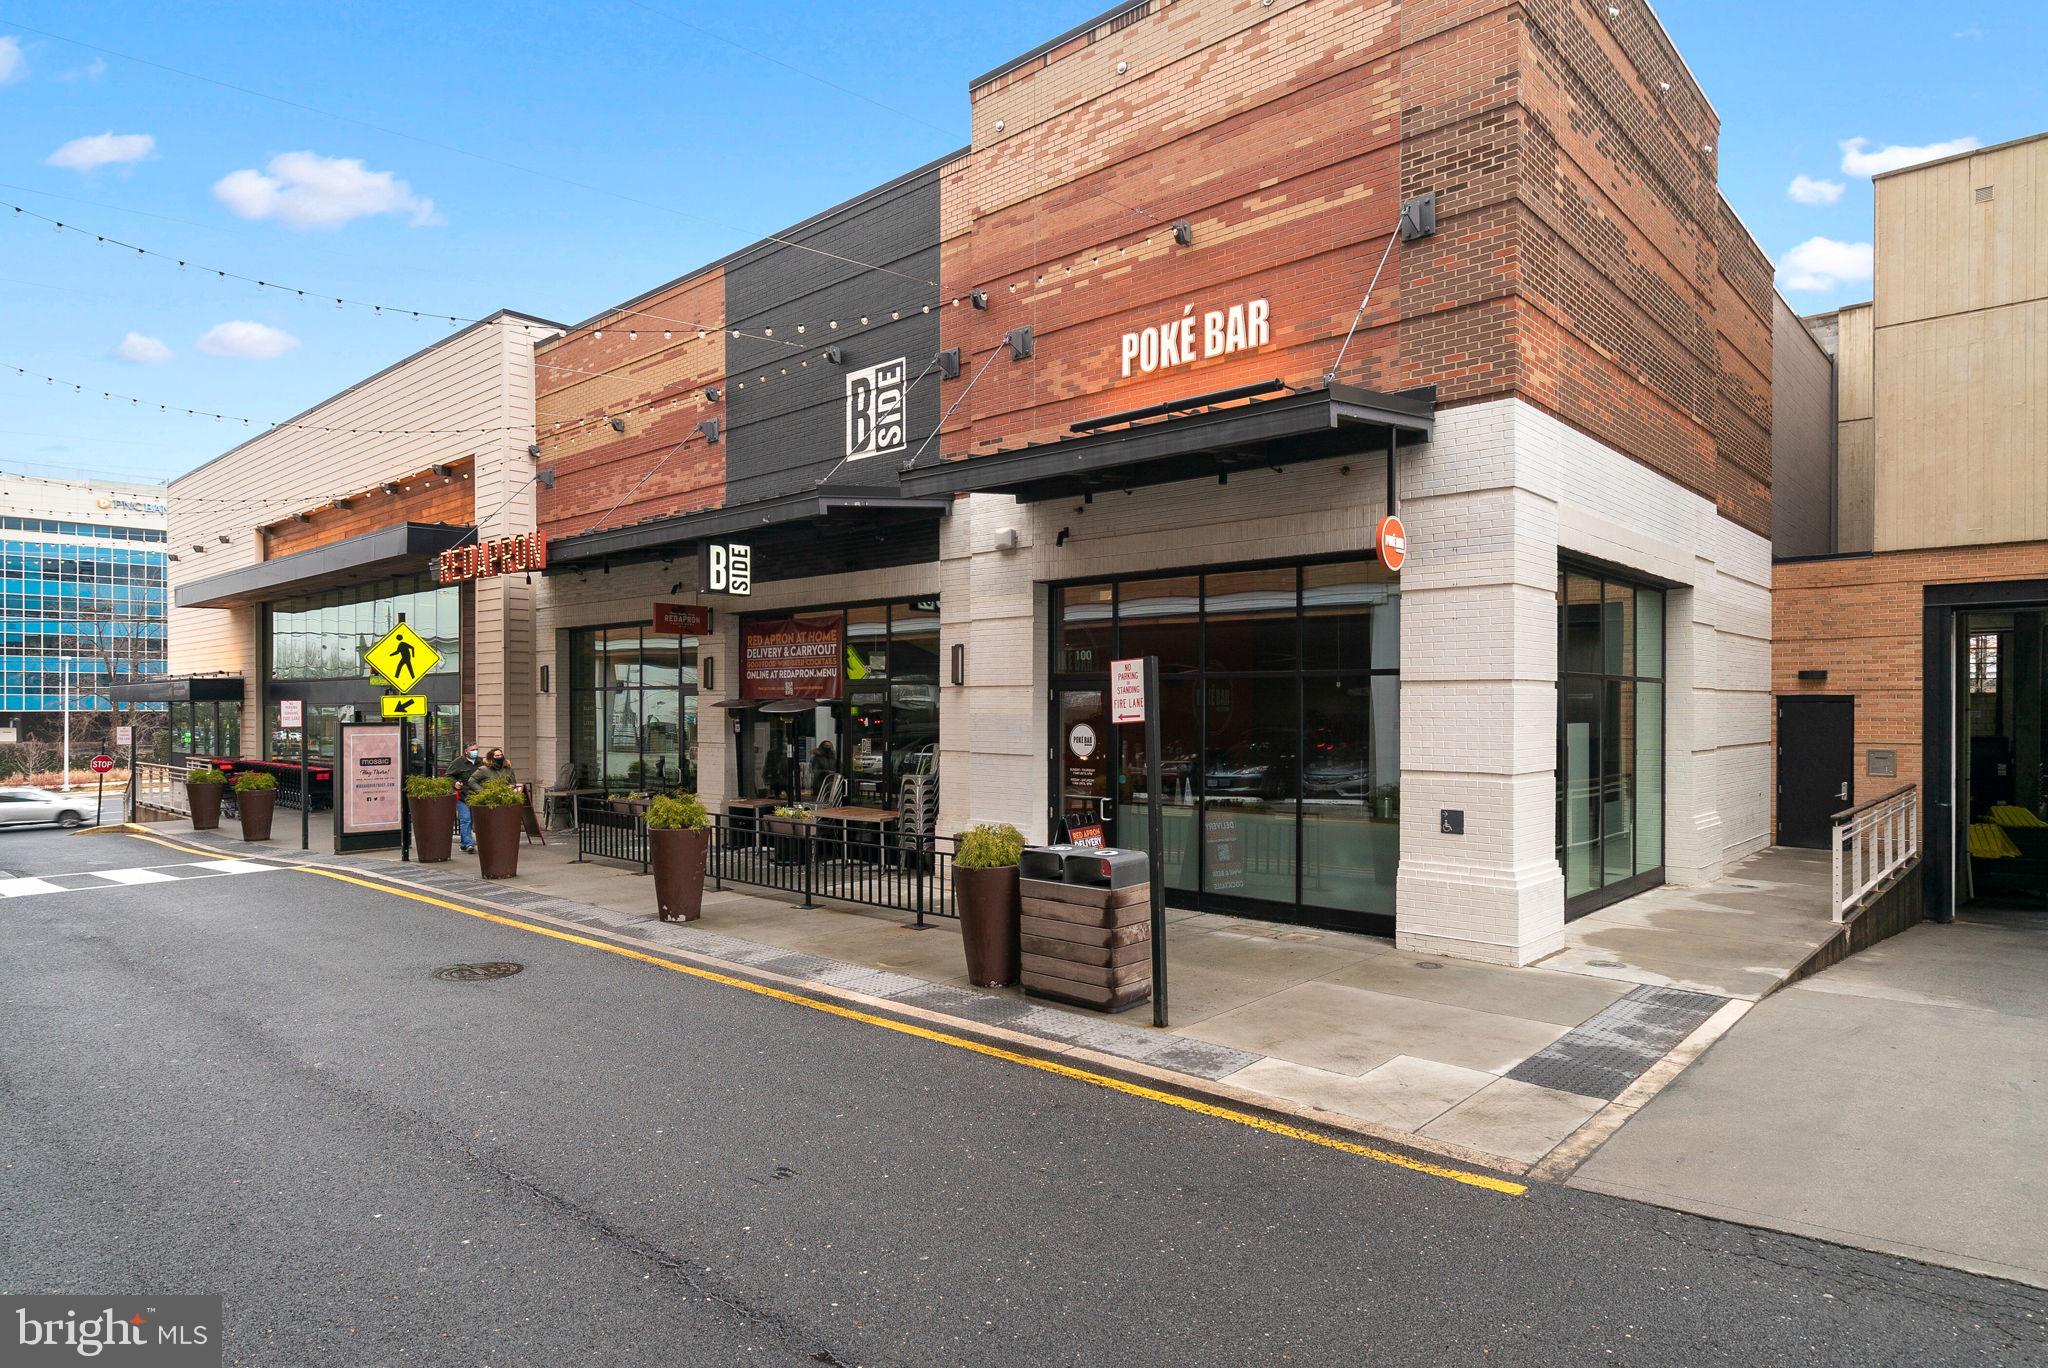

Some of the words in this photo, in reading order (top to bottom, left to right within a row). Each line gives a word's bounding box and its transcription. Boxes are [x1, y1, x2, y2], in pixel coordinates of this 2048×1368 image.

[1121, 302, 1197, 378] POKÉ
[1204, 299, 1270, 359] BAR
[851, 377, 871, 454] B
[878, 366, 902, 448] SIDE
[113, 500, 143, 512] PNC
[710, 545, 727, 590] B
[731, 547, 748, 591] SIDE
[747, 634, 762, 646] RED
[764, 632, 794, 646] APRON
[796, 631, 807, 643] AT
[808, 630, 837, 642] HOME
[746, 647, 782, 659] DELIVERY
[783, 646, 790, 657] &
[790, 644, 837, 656] CARRYOUT
[1076, 650, 1092, 660] 100
[746, 670, 769, 679] ONLINE
[770, 670, 779, 678] AT
[779, 668, 837, 678] REDAPRON.MENU
[1118, 672, 1138, 680] PARKING
[1117, 686, 1140, 694] STANDING
[1114, 699, 1127, 708] FIRE
[1129, 698, 1144, 708] LANE
[1072, 831, 1083, 839] RED
[1084, 828, 1100, 837] APRON
